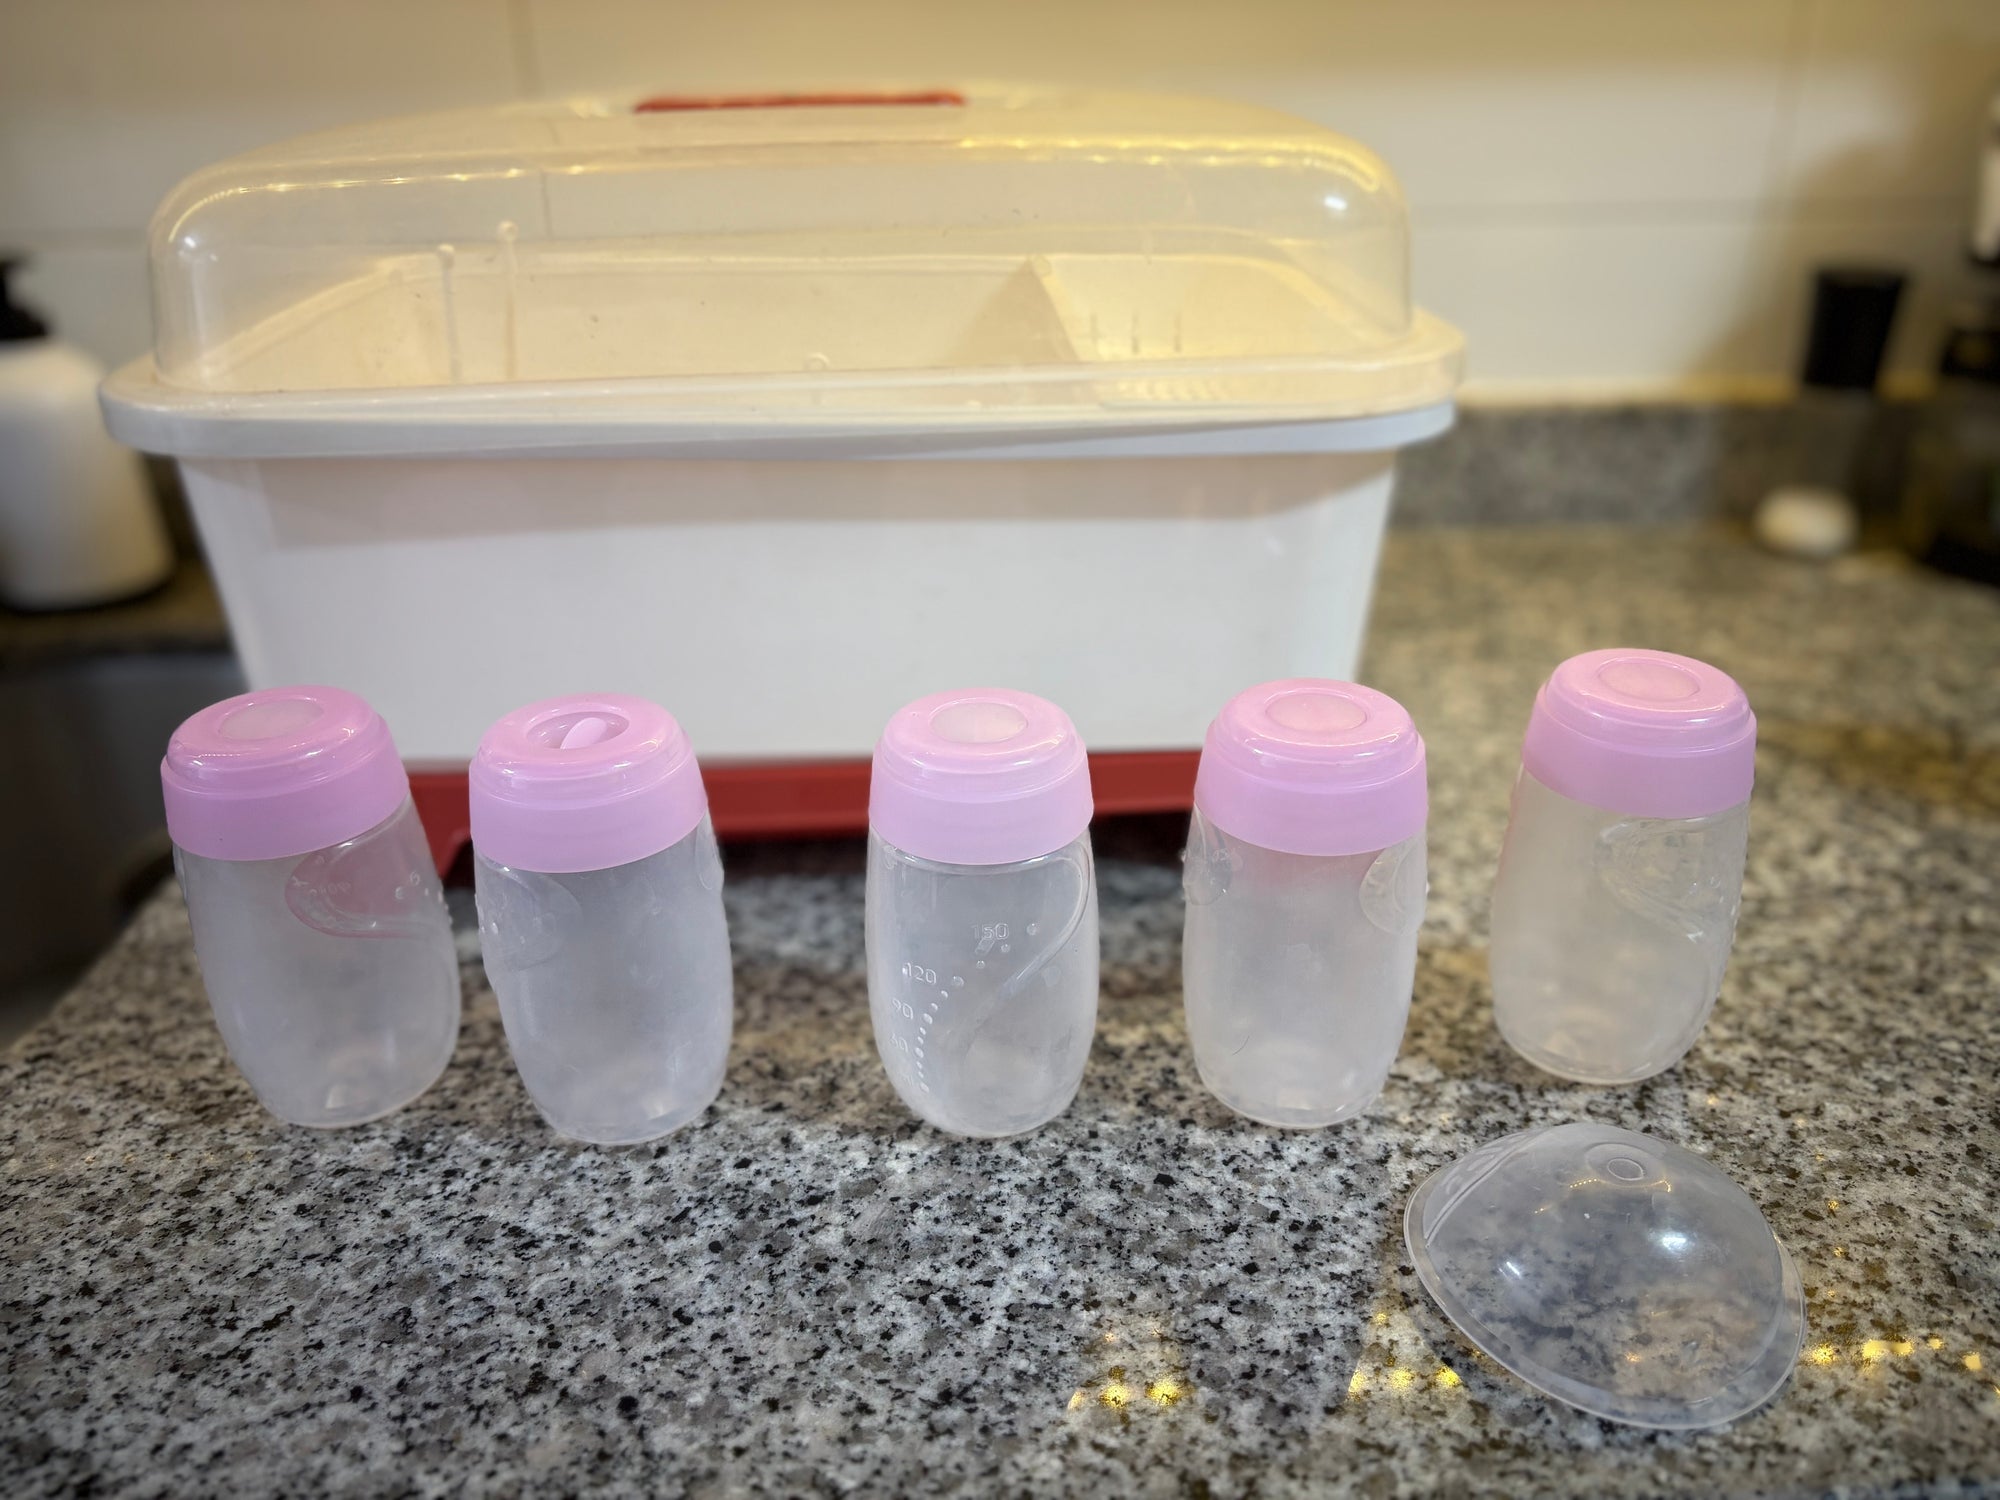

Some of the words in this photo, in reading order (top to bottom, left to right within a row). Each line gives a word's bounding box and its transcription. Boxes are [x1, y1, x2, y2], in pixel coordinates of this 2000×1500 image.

[971, 922, 1010, 940] 150
[902, 962, 938, 986] 120
[891, 997, 914, 1020] 90
